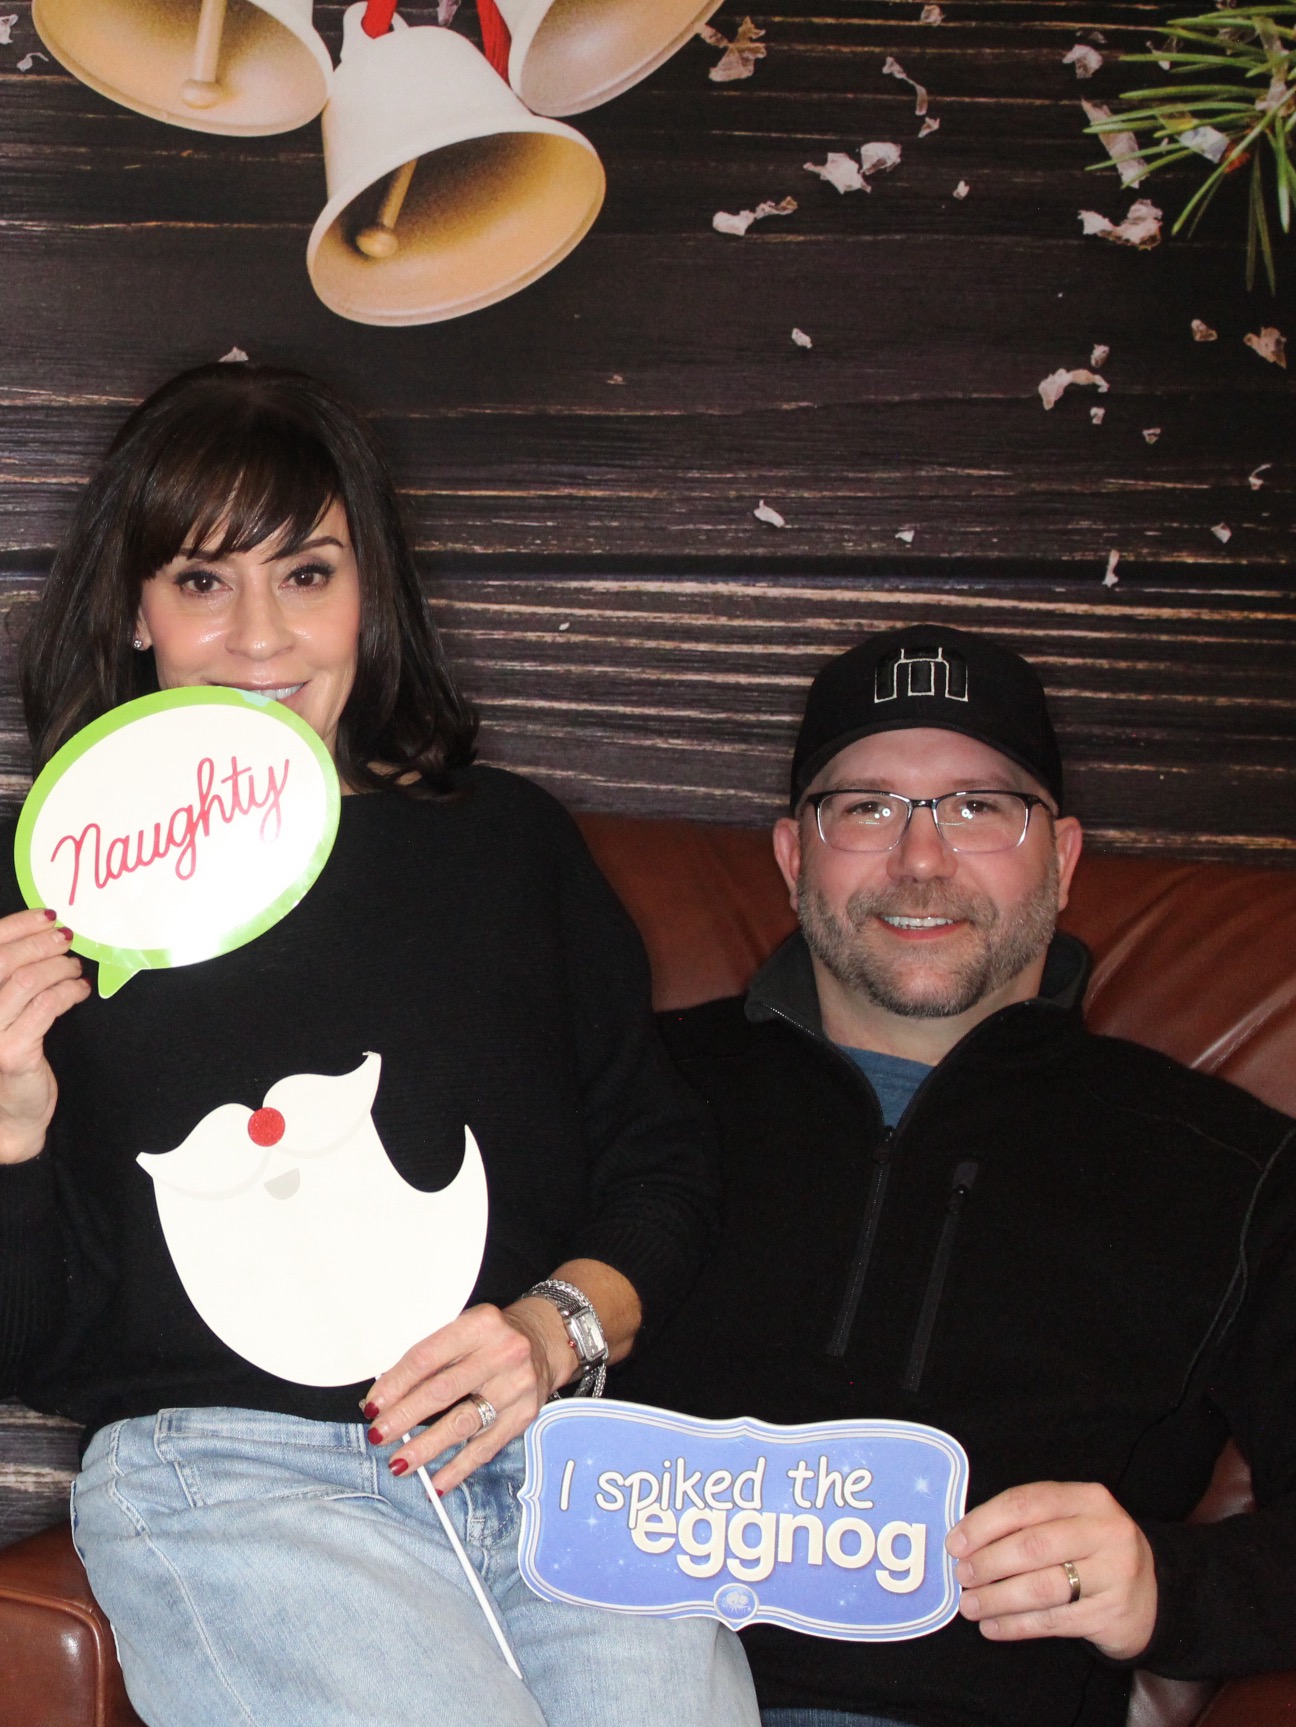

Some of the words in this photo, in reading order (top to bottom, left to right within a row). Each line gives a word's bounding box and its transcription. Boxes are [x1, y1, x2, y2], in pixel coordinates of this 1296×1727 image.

[50, 755, 290, 906] Naughty
[559, 1459, 576, 1511] I
[594, 1456, 766, 1530] spiked
[787, 1455, 874, 1510] the
[630, 1499, 927, 1593] eggnog
